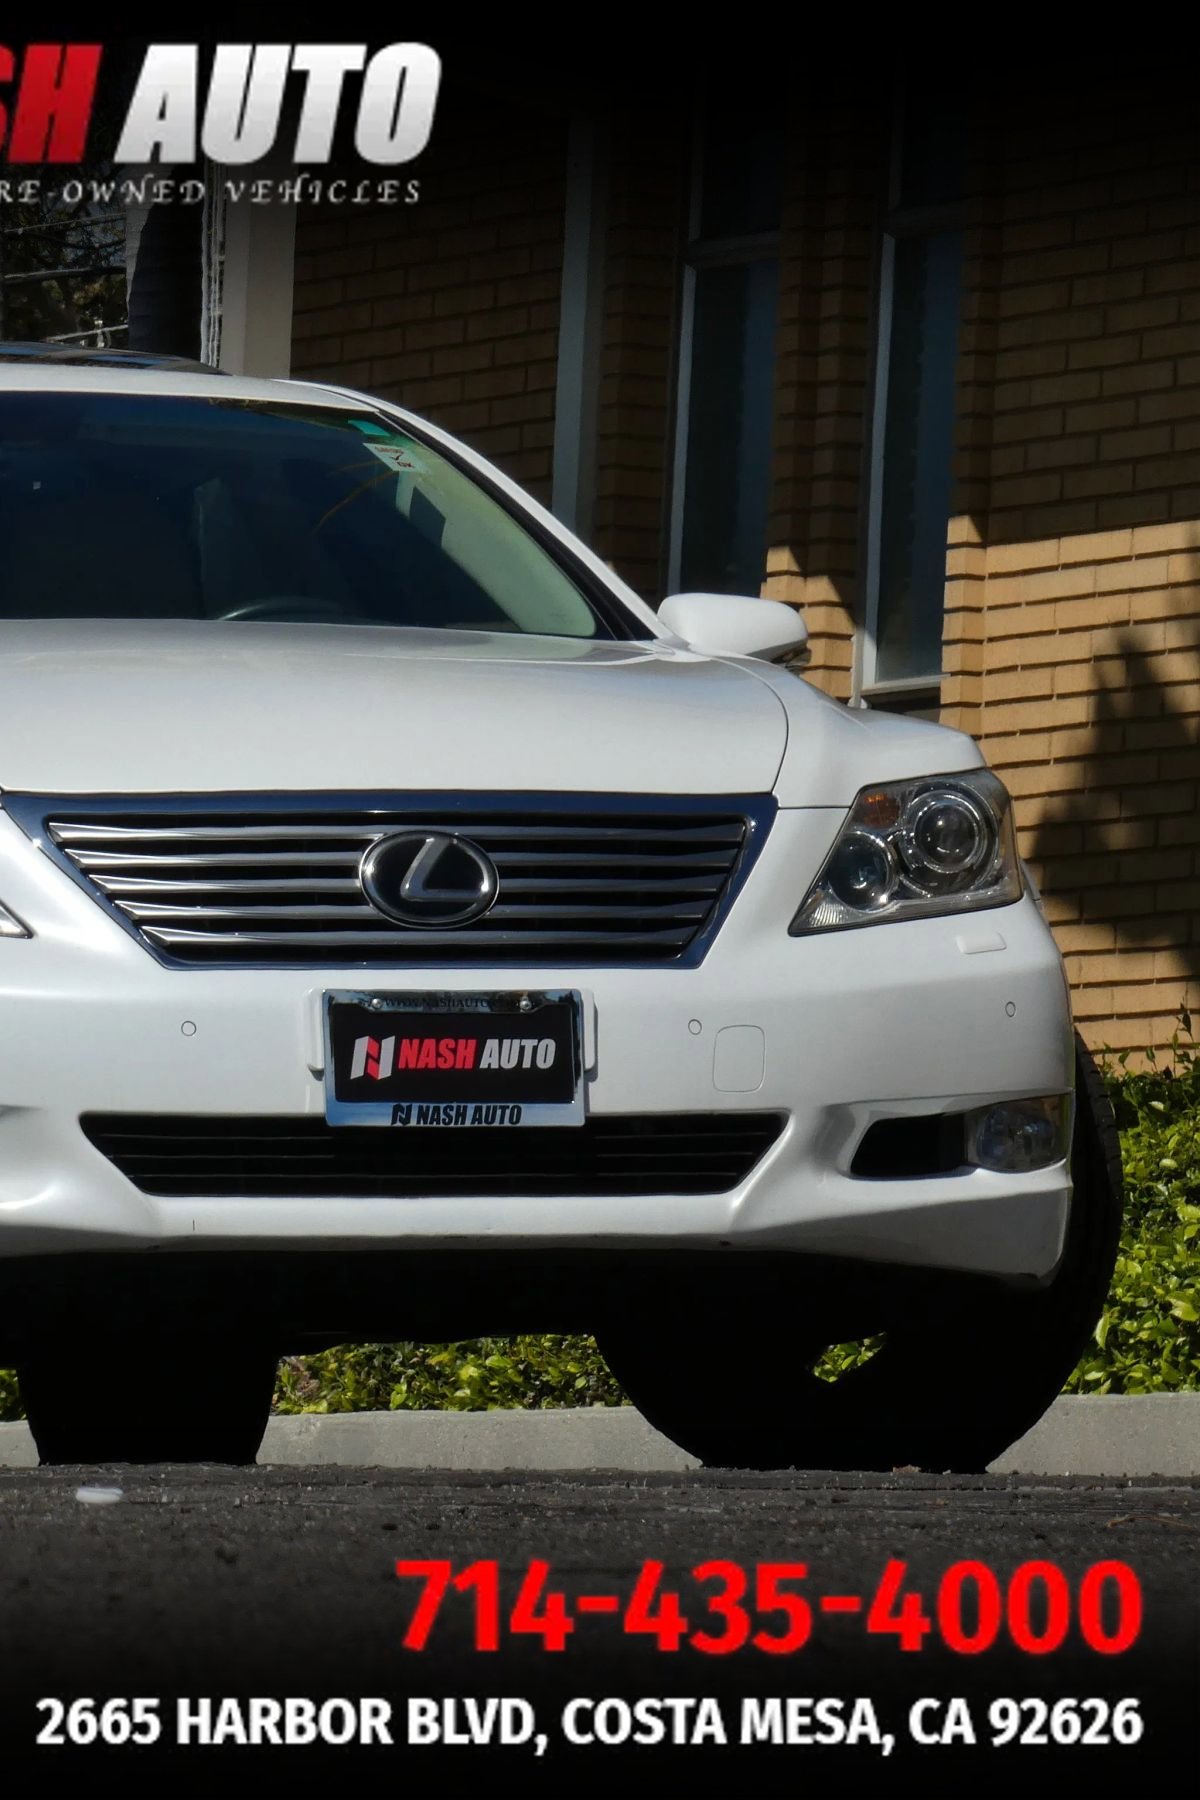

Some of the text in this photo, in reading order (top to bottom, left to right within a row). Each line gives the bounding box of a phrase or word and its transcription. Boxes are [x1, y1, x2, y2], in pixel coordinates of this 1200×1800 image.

[398, 1039, 477, 1069] NASH
[479, 1038, 556, 1069] AUTO
[416, 1104, 467, 1126] NASH
[470, 1104, 522, 1126] AUTO
